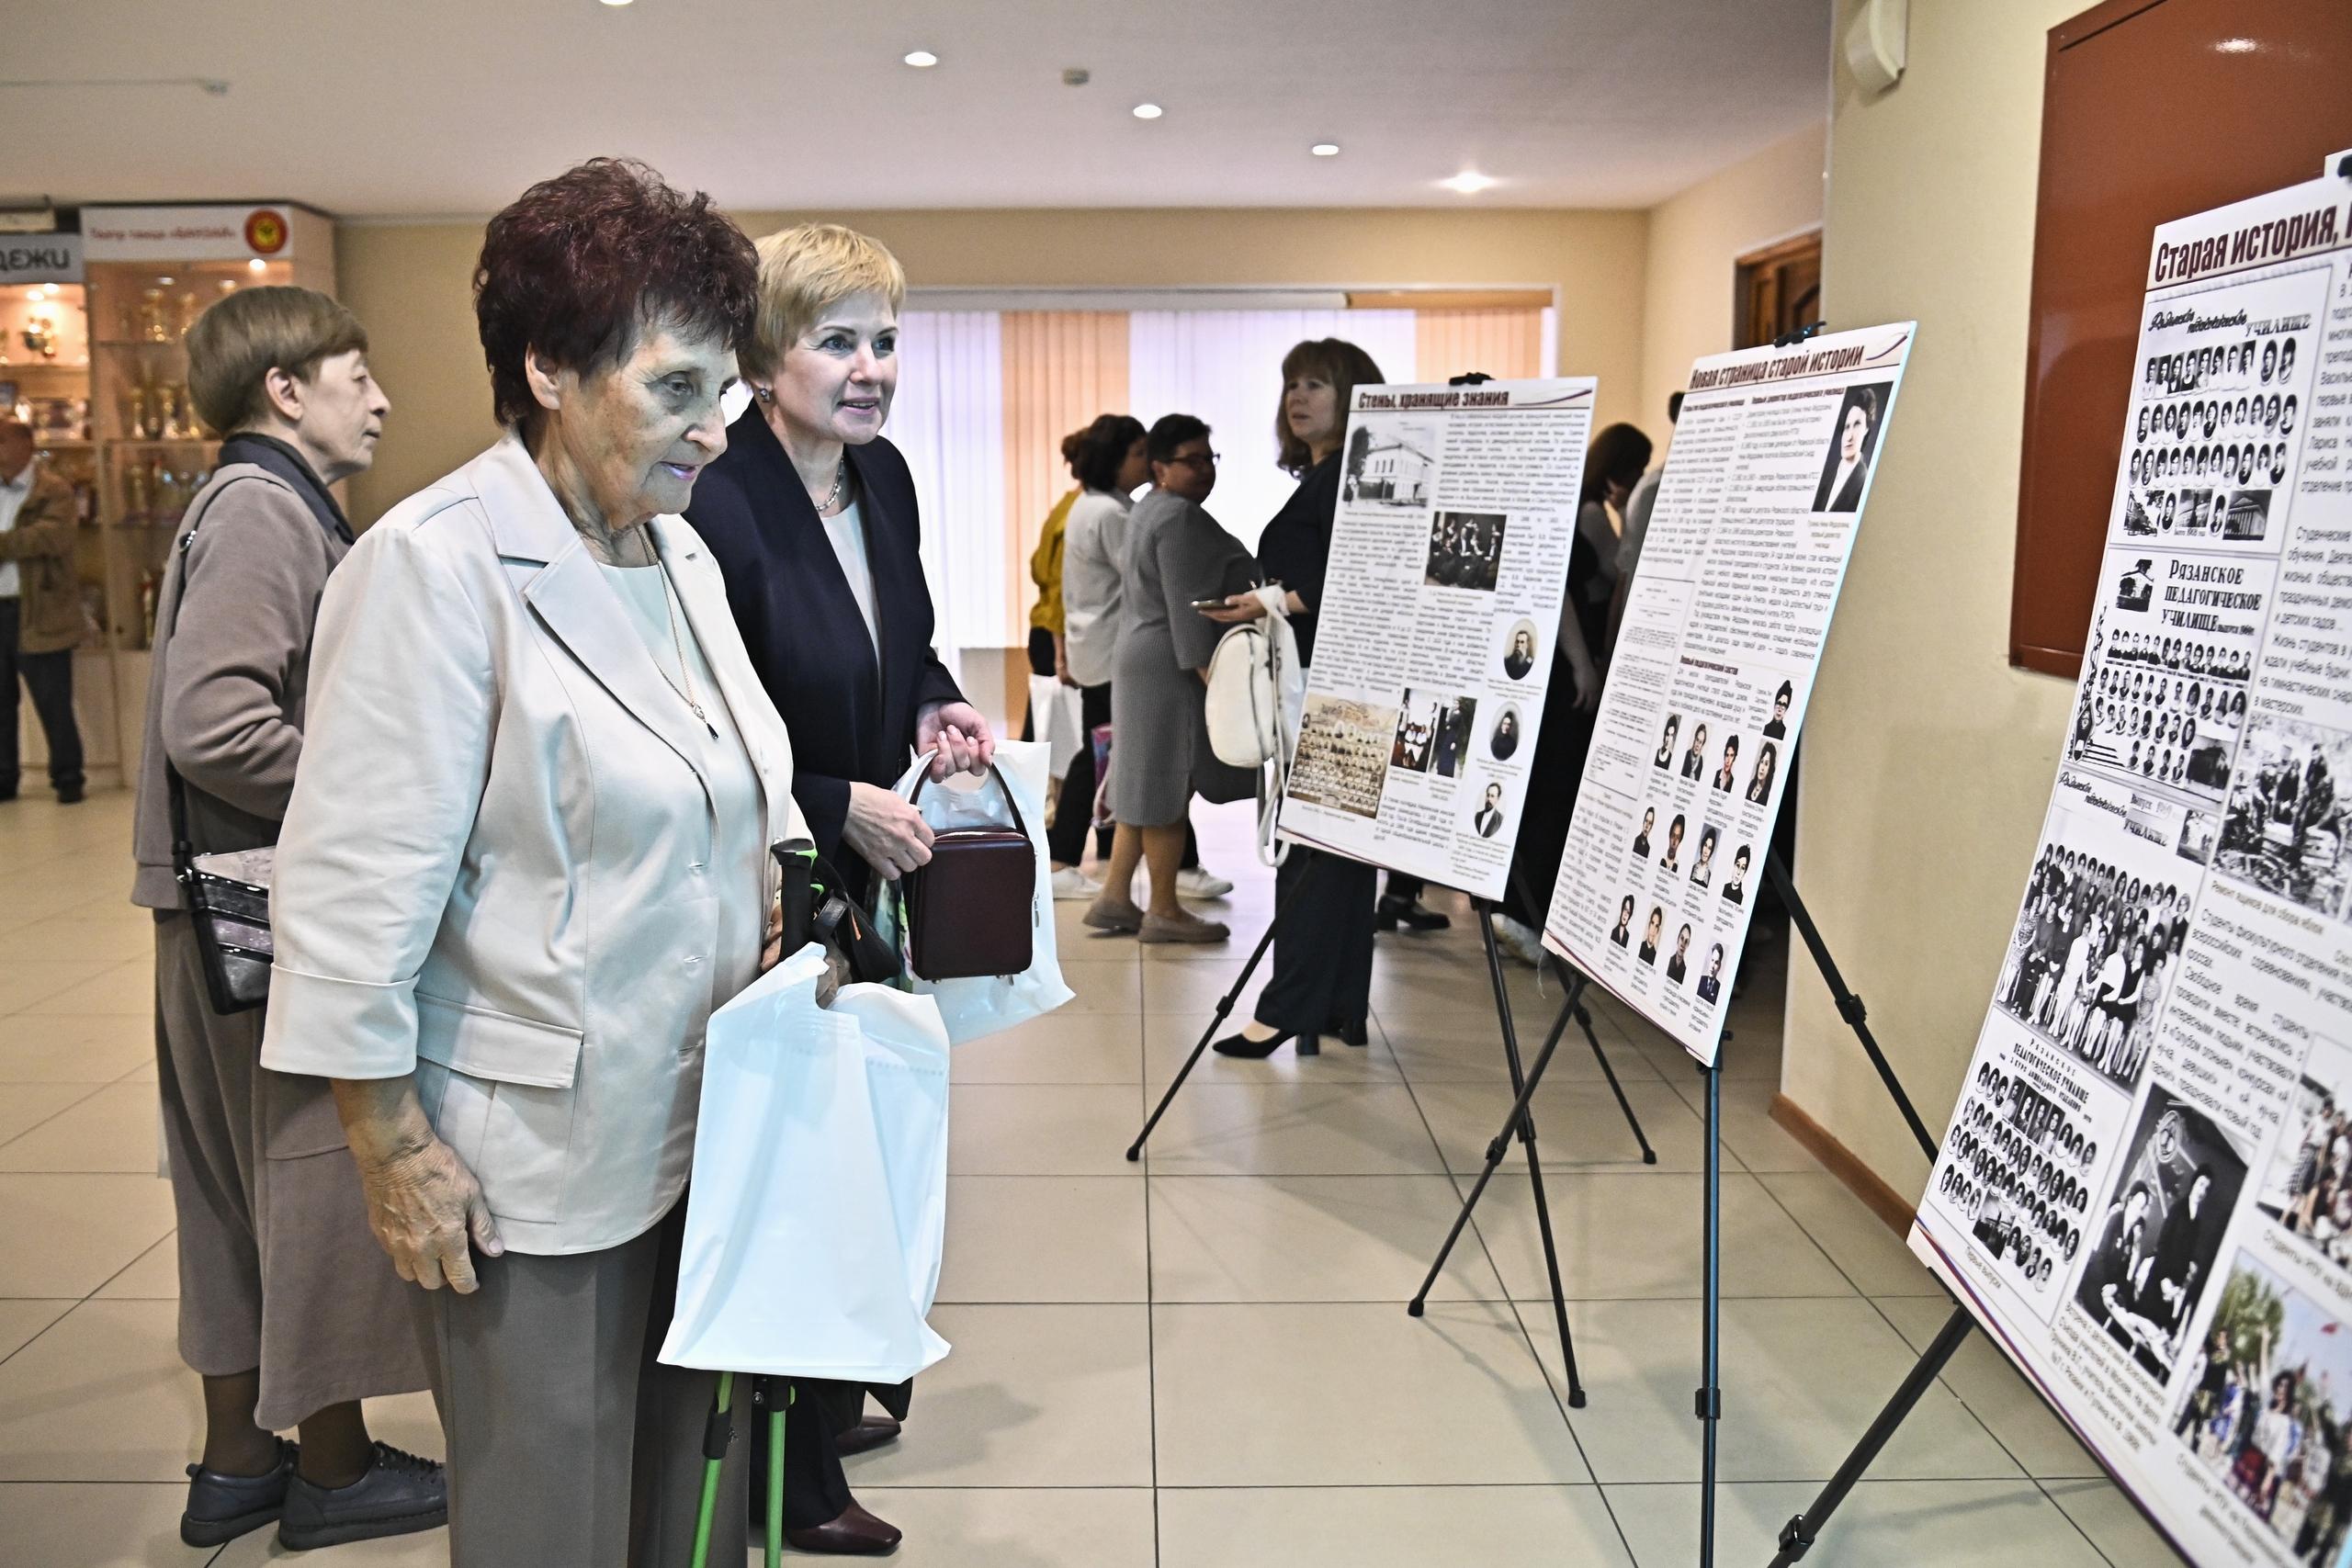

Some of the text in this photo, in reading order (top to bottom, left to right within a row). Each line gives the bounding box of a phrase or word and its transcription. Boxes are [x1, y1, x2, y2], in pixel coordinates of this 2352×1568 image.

[2154, 233, 2229, 282] Старая
[2230, 206, 2339, 265] история,
[1689, 345, 1865, 389] Новая страница старой истории
[1398, 392, 1461, 411] хранящие
[1463, 390, 1509, 406] знания
[2165, 585, 2263, 611] ПЕДАГОГИЧЕСКОЕ
[2161, 608, 2220, 634] УЧИЛИЩЕ
[2013, 1043, 2063, 1084] ПЕДАГОГИЧЕСКОЕ
